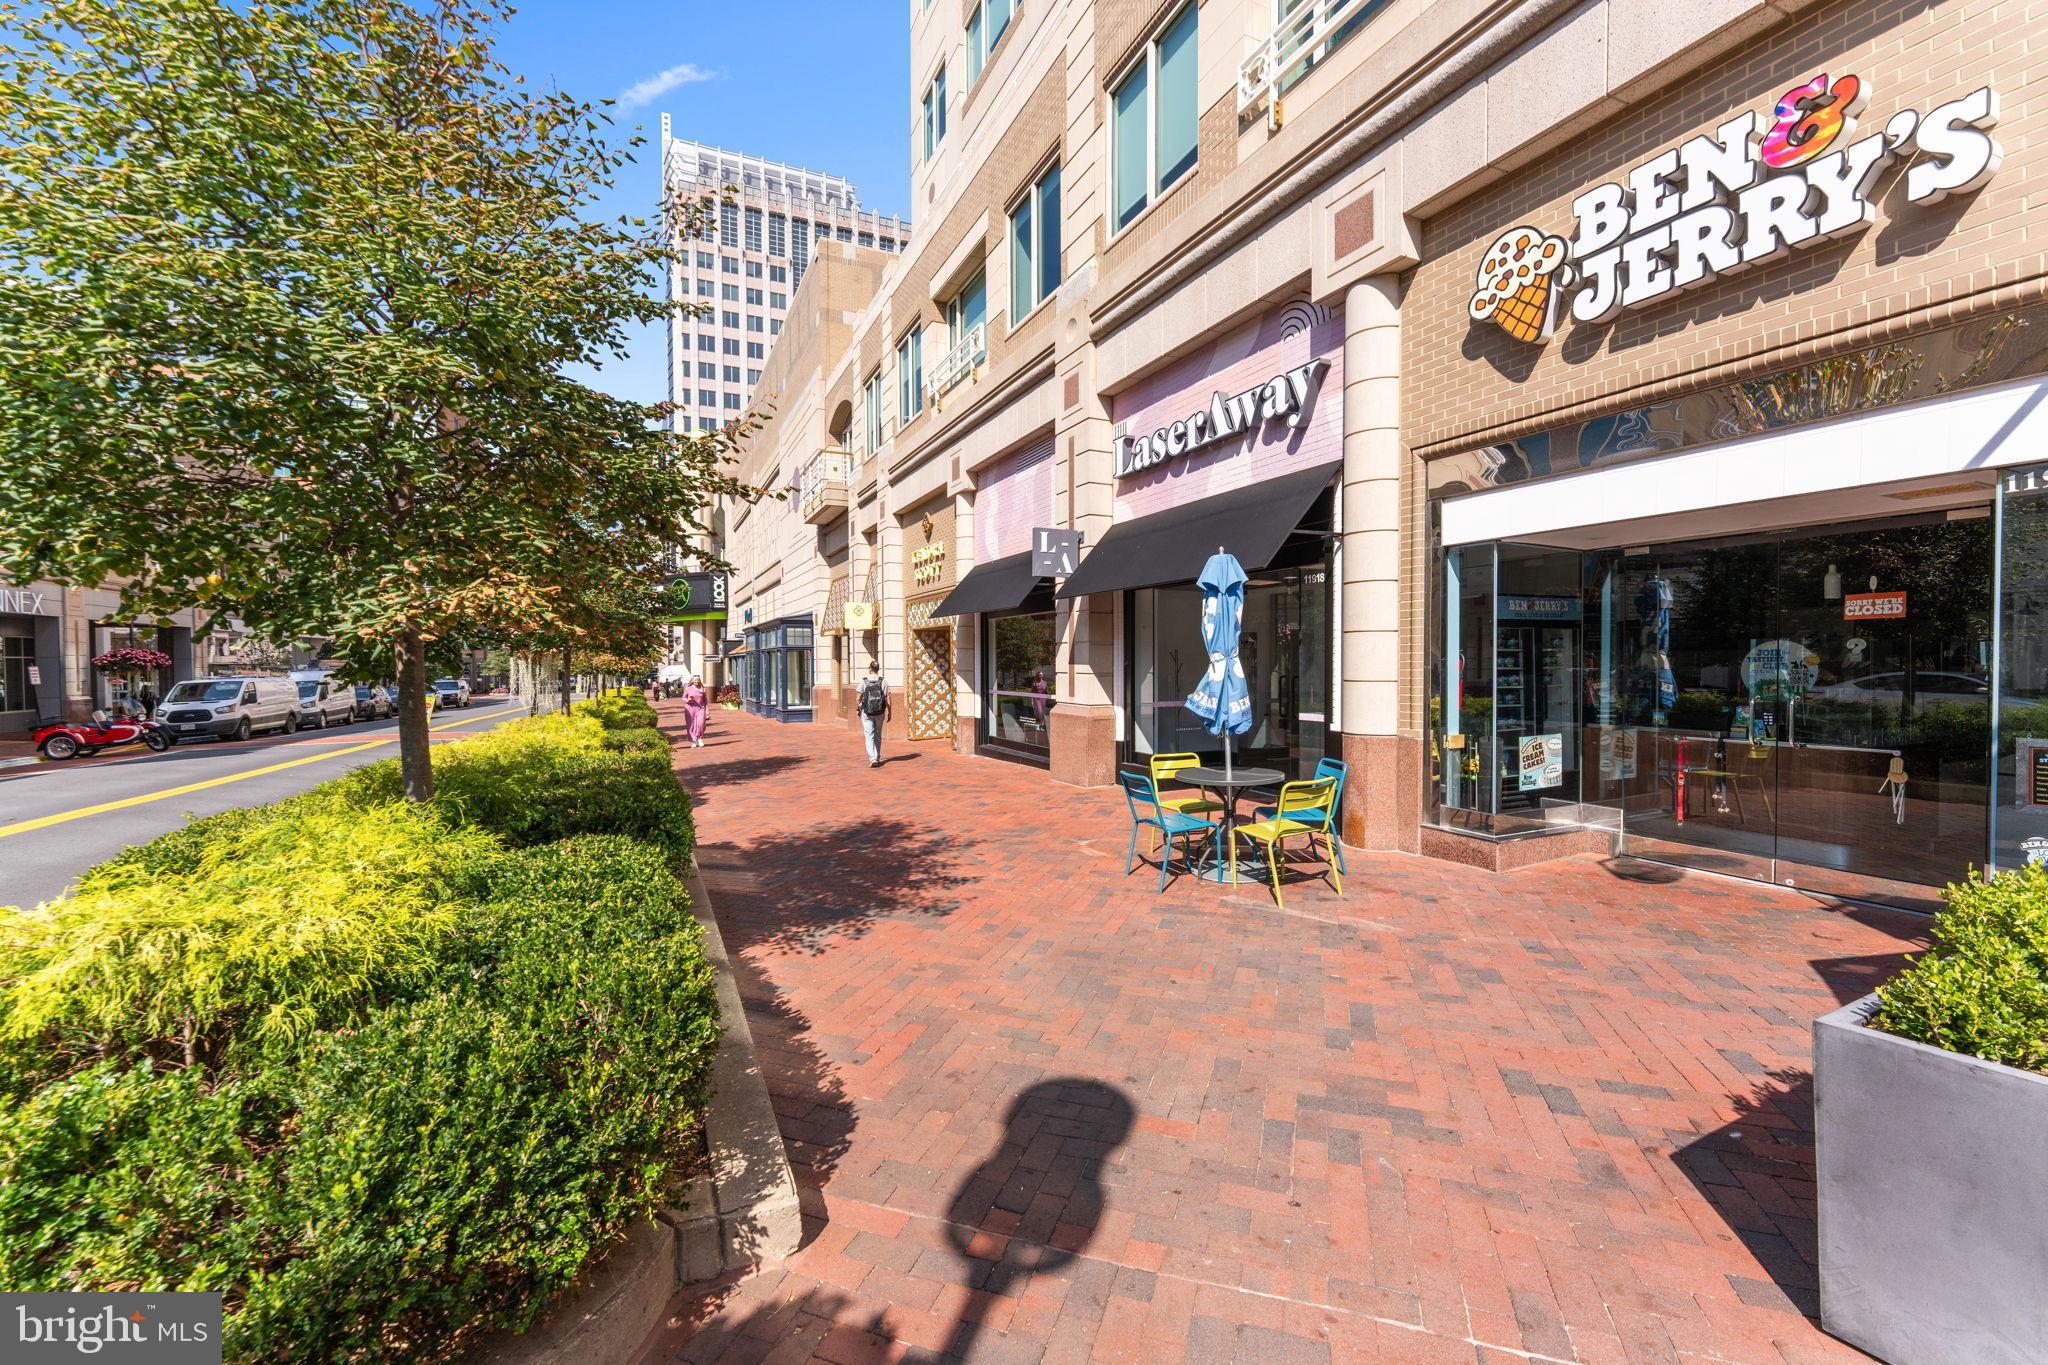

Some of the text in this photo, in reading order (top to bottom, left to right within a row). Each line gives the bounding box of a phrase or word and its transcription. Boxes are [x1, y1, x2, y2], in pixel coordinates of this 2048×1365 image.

[1572, 72, 1872, 258] BEN &
[1573, 85, 2001, 323] JERRY'S
[1113, 357, 1331, 479] LaserAway
[1304, 572, 1325, 584] 11918
[713, 576, 725, 602] LOOK
[1508, 599, 1527, 611] BEN
[1535, 599, 1569, 612] JERRY'S
[1874, 597, 1904, 605] WE'RE
[1845, 603, 1903, 616] CLOSED
[1531, 741, 1543, 752] ICE
[1522, 749, 1545, 764] CREAM
[1523, 757, 1546, 770] CAKES!
